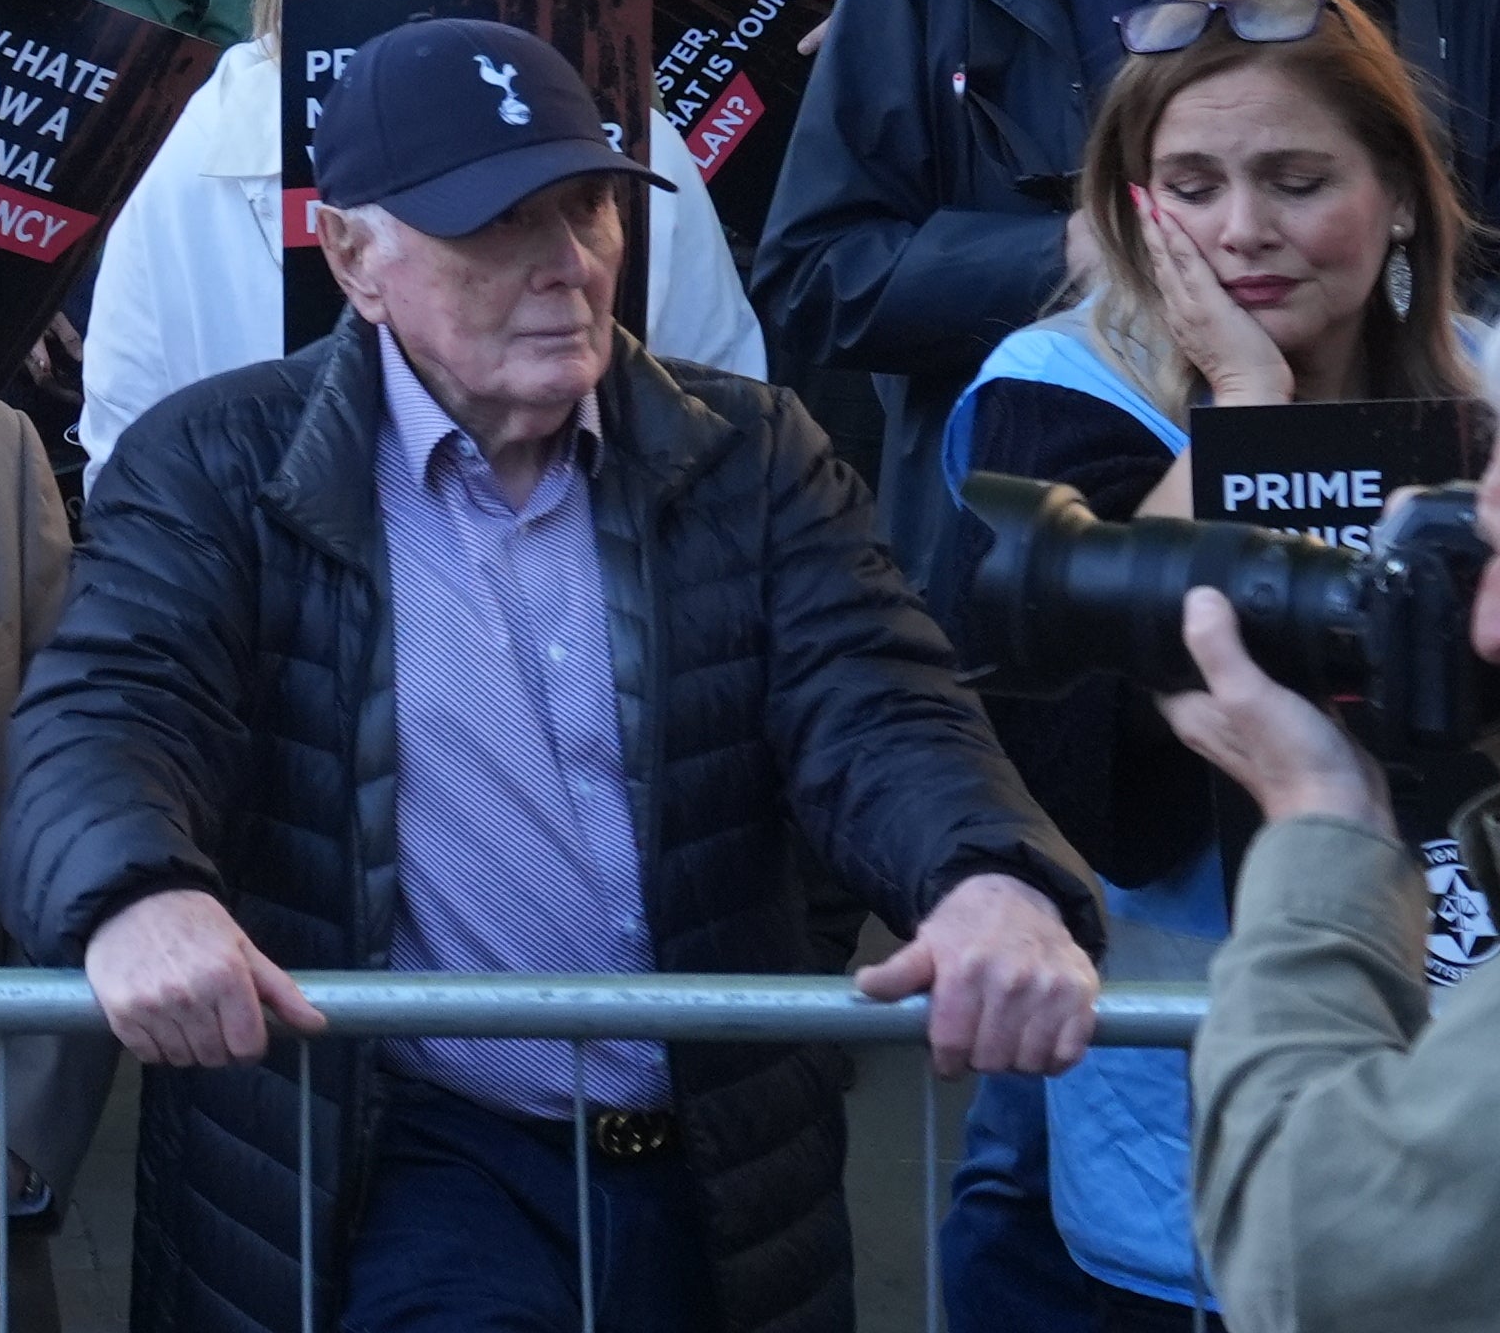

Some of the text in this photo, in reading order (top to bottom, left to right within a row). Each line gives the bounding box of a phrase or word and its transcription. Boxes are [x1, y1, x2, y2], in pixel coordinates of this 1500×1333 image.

[654, 26, 719, 99] STER,
[667, 79, 710, 131] HAT
[700, 54, 734, 83] IS
[40, 105, 70, 143] A
[693, 95, 753, 171] LAN?
[1222, 469, 1383, 511] PRIME
